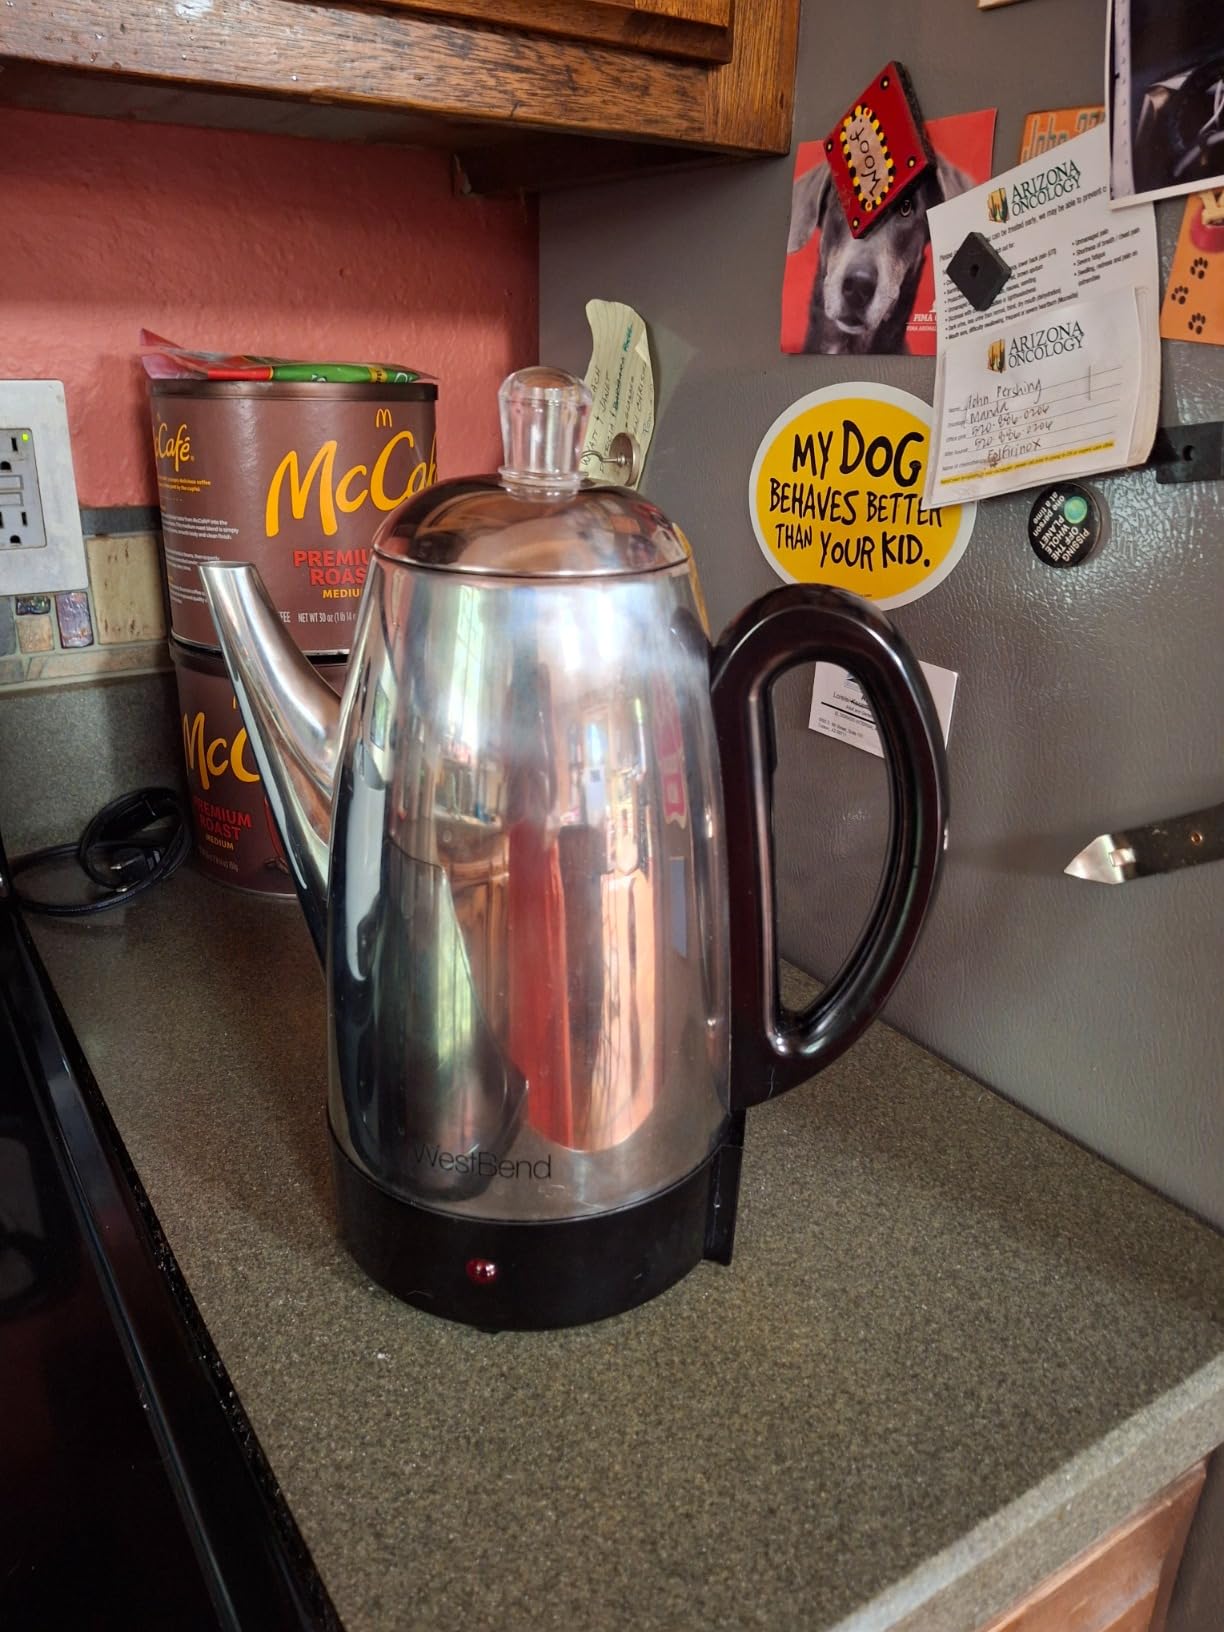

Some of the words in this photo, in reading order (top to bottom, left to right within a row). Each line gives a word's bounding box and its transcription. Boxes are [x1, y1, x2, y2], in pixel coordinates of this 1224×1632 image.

[1011, 159, 1081, 203] ARIZONA
[1011, 173, 1081, 217] ONCOLOGY
[1008, 336, 1084, 369] ONCOLOGY
[1009, 320, 1085, 355] ARIZONA
[156, 422, 191, 472] Café
[792, 430, 834, 480] MY
[839, 420, 925, 487] DOG
[769, 478, 859, 526] BEHAVES
[866, 491, 942, 528] BETTER
[1049, 491, 1058, 502] at
[1052, 495, 1065, 511] one
[1032, 506, 1048, 525] time
[1032, 508, 1054, 537] person
[1039, 514, 1065, 549] PLANET
[776, 523, 812, 550] THAN
[820, 531, 876, 572] YOUR
[882, 531, 931, 569] KID.
[1044, 524, 1070, 555] WHOLE
[1061, 527, 1091, 562] PISSING
[1065, 526, 1079, 546] OFF
[293, 549, 368, 568] PREMIU
[1050, 544, 1066, 562] THE
[310, 567, 367, 586] ROAS
[322, 588, 362, 599] MEDIU
[298, 612, 308, 623] NET
[309, 612, 319, 623] WT
[183, 711, 261, 791] McC
[205, 833, 234, 851] MEDIUM
[413, 1144, 552, 1180] WestBend
